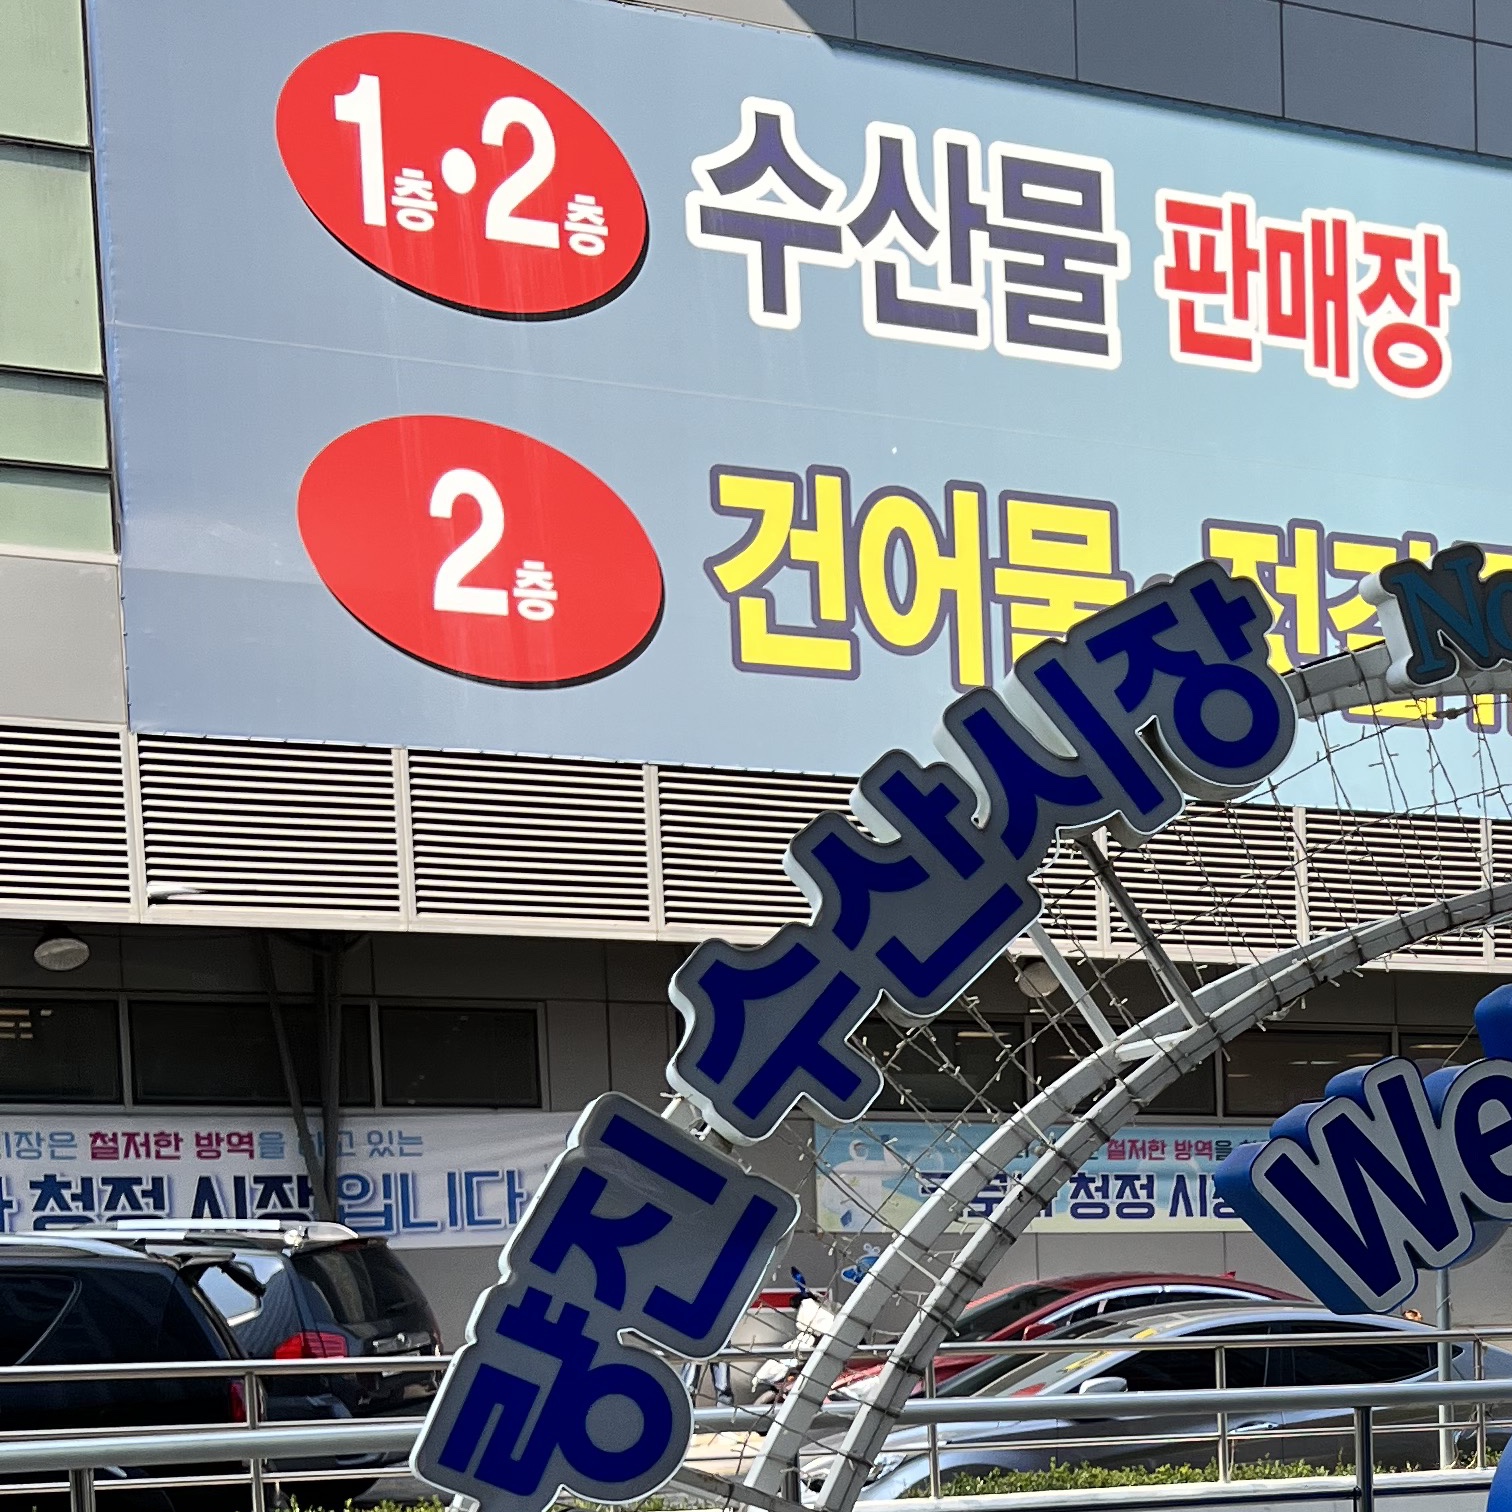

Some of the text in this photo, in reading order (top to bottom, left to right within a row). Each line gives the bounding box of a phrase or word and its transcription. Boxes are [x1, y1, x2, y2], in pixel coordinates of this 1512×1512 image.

[688, 98, 1129, 368] 수산물
[1158, 193, 1459, 396] 판매장
[428, 468, 558, 622] 2층
[704, 465, 1132, 692] 건어물
[688, 576, 1282, 1122] 수산시장
[89, 1130, 183, 1161] 철저한
[194, 1130, 285, 1161] 방역을
[366, 1129, 424, 1158] 있는
[1106, 1138, 1166, 1161] 철저한
[1173, 1138, 1232, 1161] 방역을
[29, 1173, 167, 1231] 청정
[335, 1171, 525, 1233] 입니다
[1069, 1172, 1155, 1220] 청정
